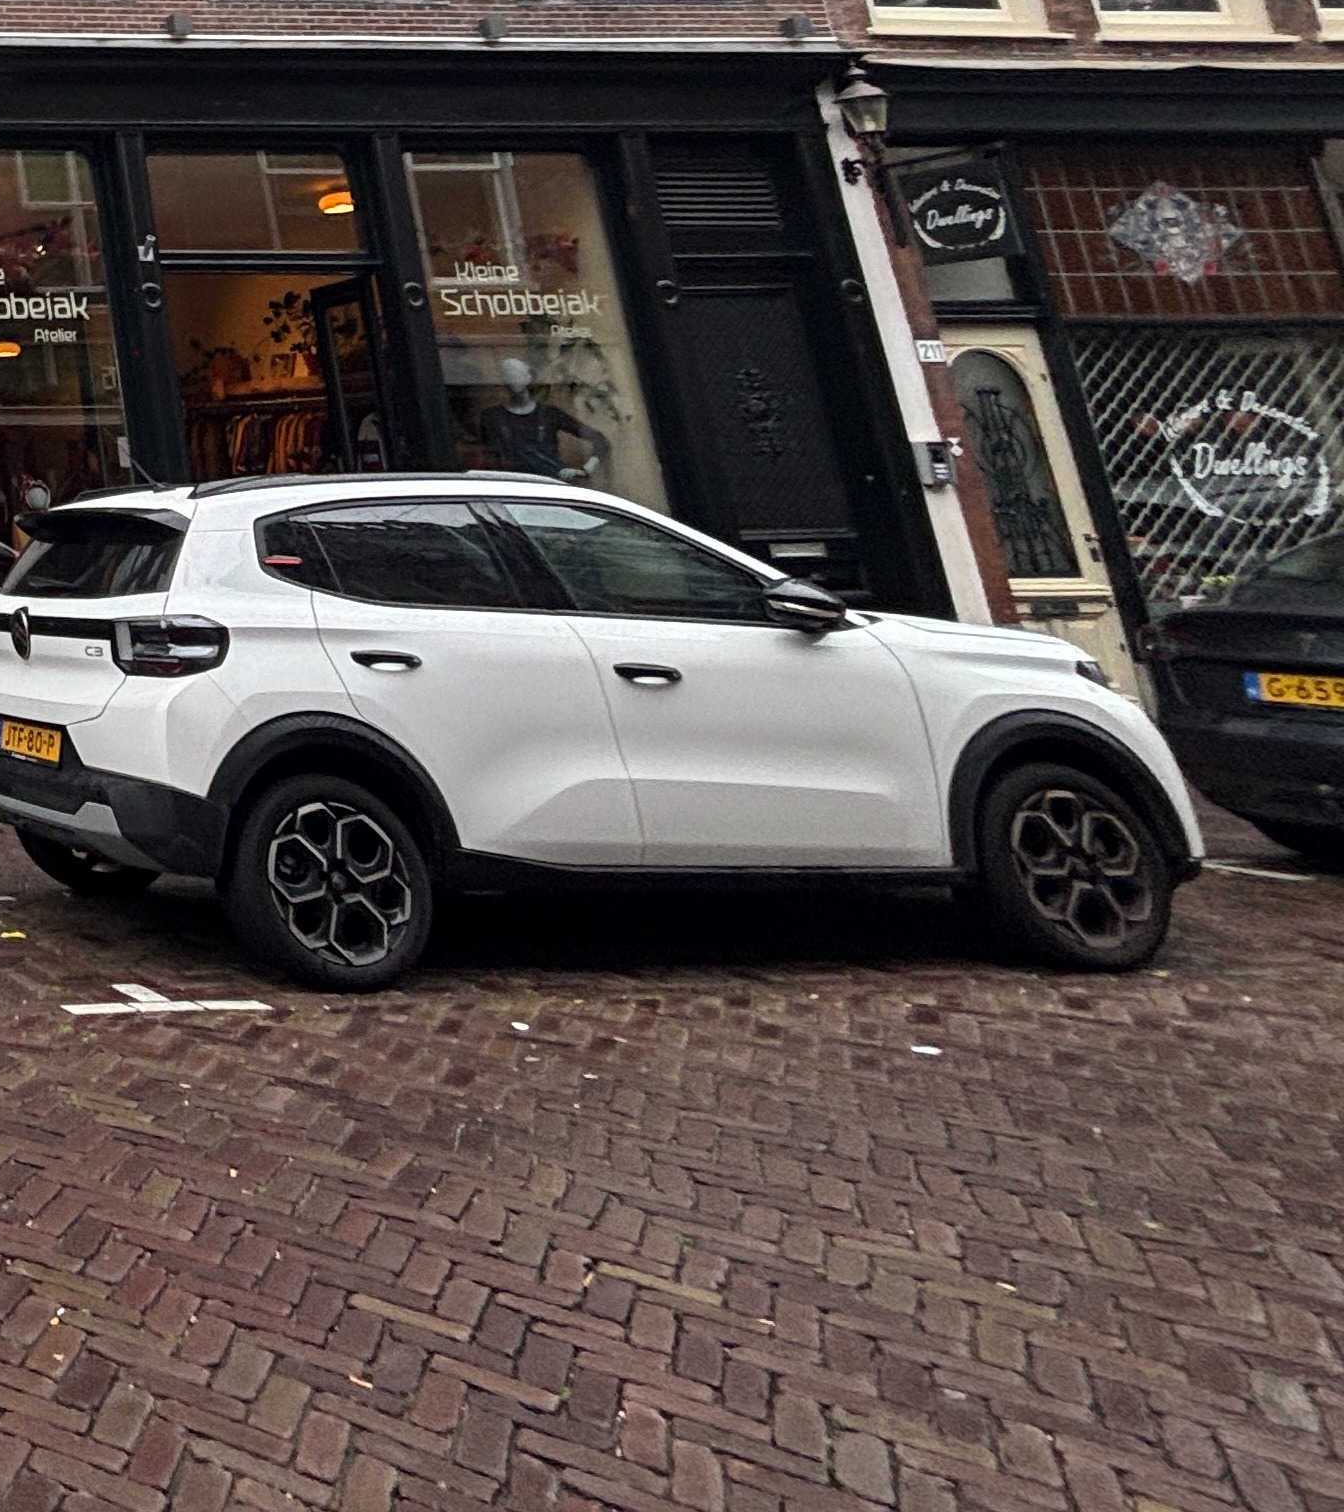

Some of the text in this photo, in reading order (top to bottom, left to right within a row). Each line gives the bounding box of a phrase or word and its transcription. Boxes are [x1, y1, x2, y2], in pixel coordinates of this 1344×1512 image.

[454, 260, 519, 283] Kleine
[34, 328, 77, 343] Atelier
[85, 646, 103, 657] C3
